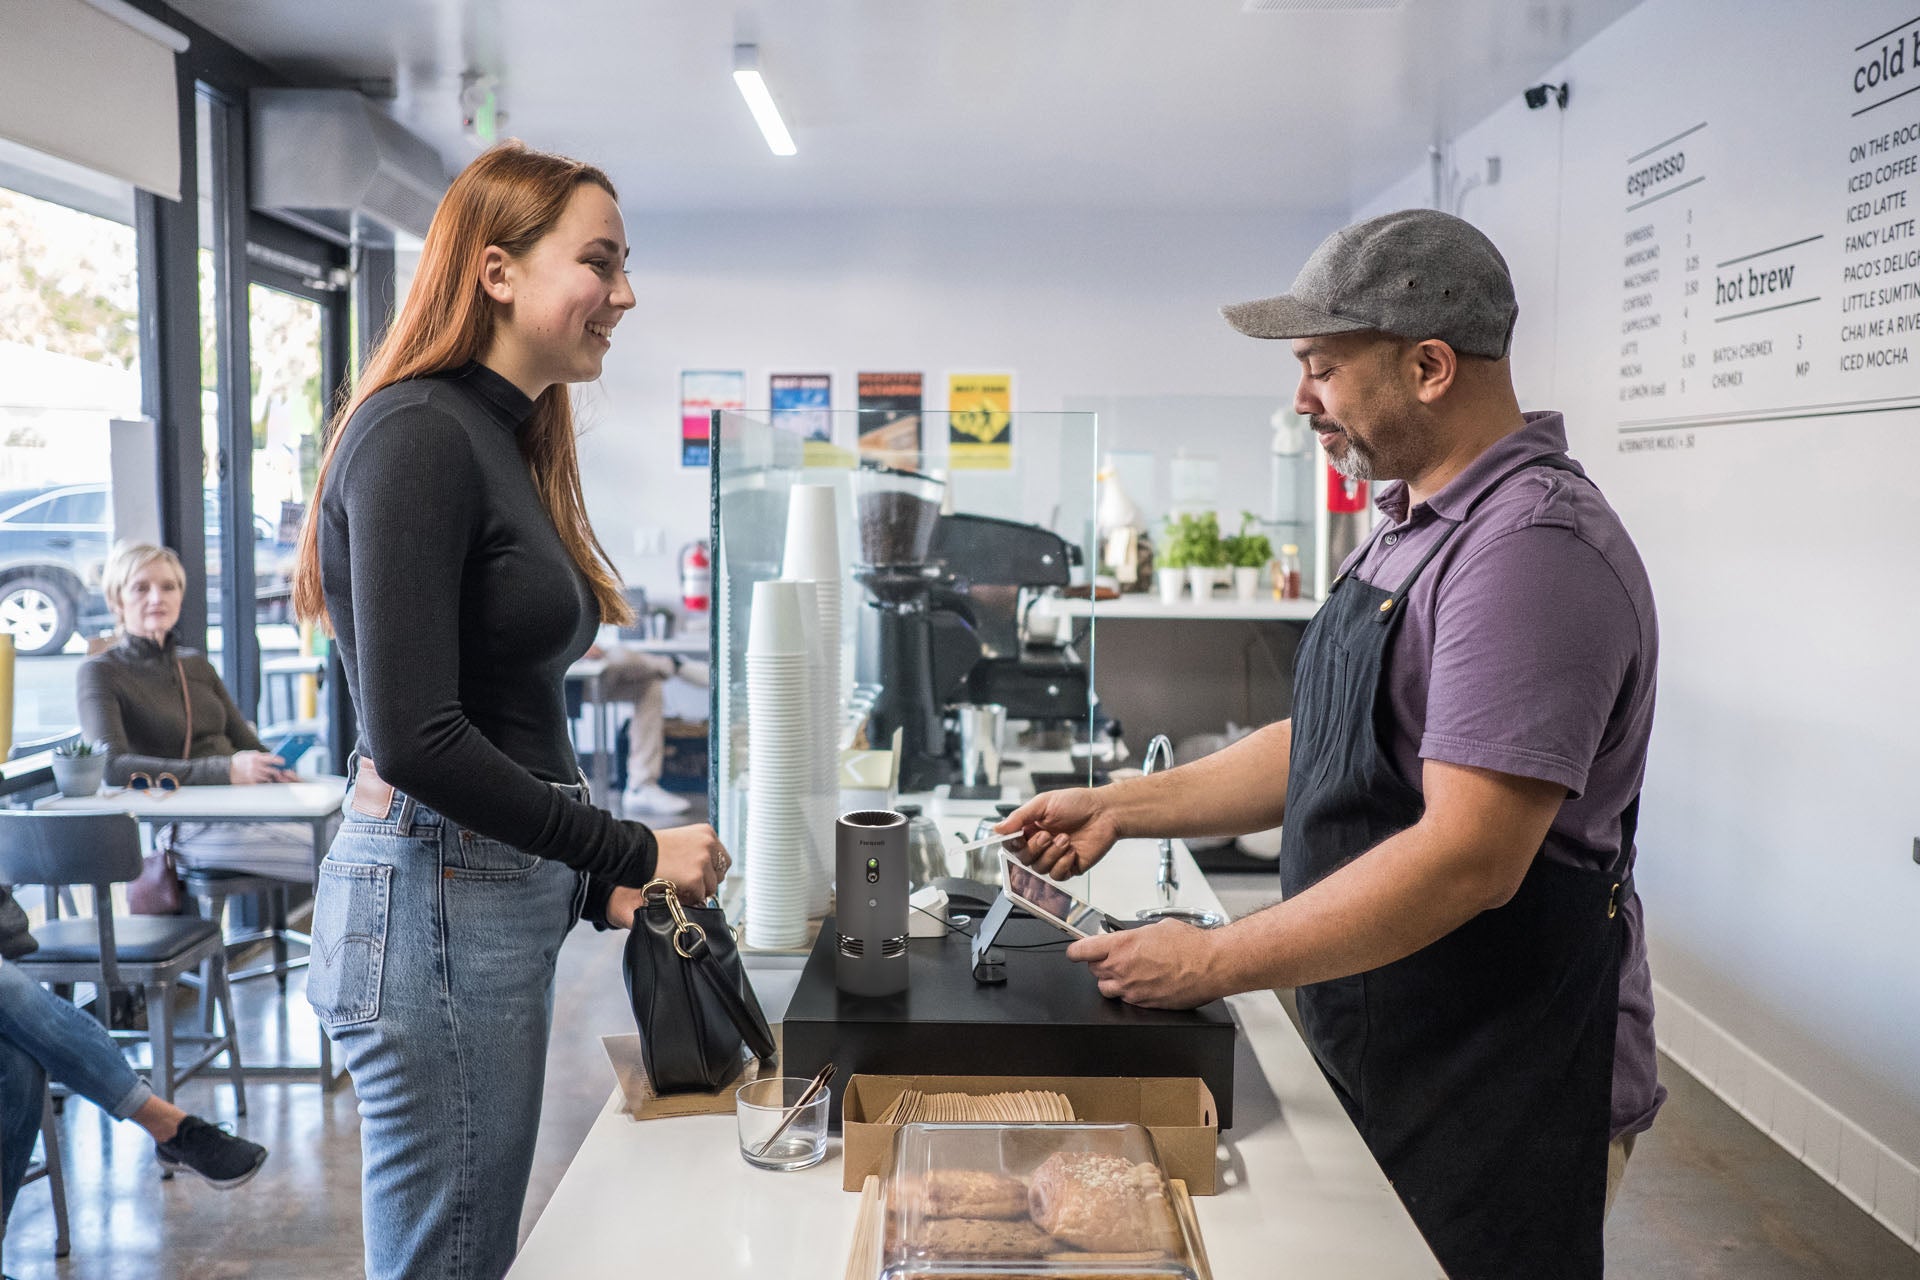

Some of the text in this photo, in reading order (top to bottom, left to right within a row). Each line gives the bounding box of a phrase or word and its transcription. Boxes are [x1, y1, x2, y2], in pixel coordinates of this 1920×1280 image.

[1854, 38, 1904, 93] cold
[1850, 121, 1920, 163] ON THE ROC
[1627, 152, 1685, 197] espresso
[1848, 155, 1917, 193] ICED COFFEE
[1847, 190, 1907, 224] ICED LATTE
[1845, 219, 1915, 253] FANCY LATTE
[1716, 264, 1795, 305] hot brew
[1844, 259, 1881, 283] PACO'S
[1843, 291, 1875, 313] LITTLE
[1841, 313, 1920, 342] CHAI ME A RIVE
[1713, 346, 1738, 363] BATCH
[1740, 340, 1773, 360] CHEMEX
[1840, 347, 1908, 371] ICED MOCHA
[1712, 361, 1810, 389] CHEMEX MP
